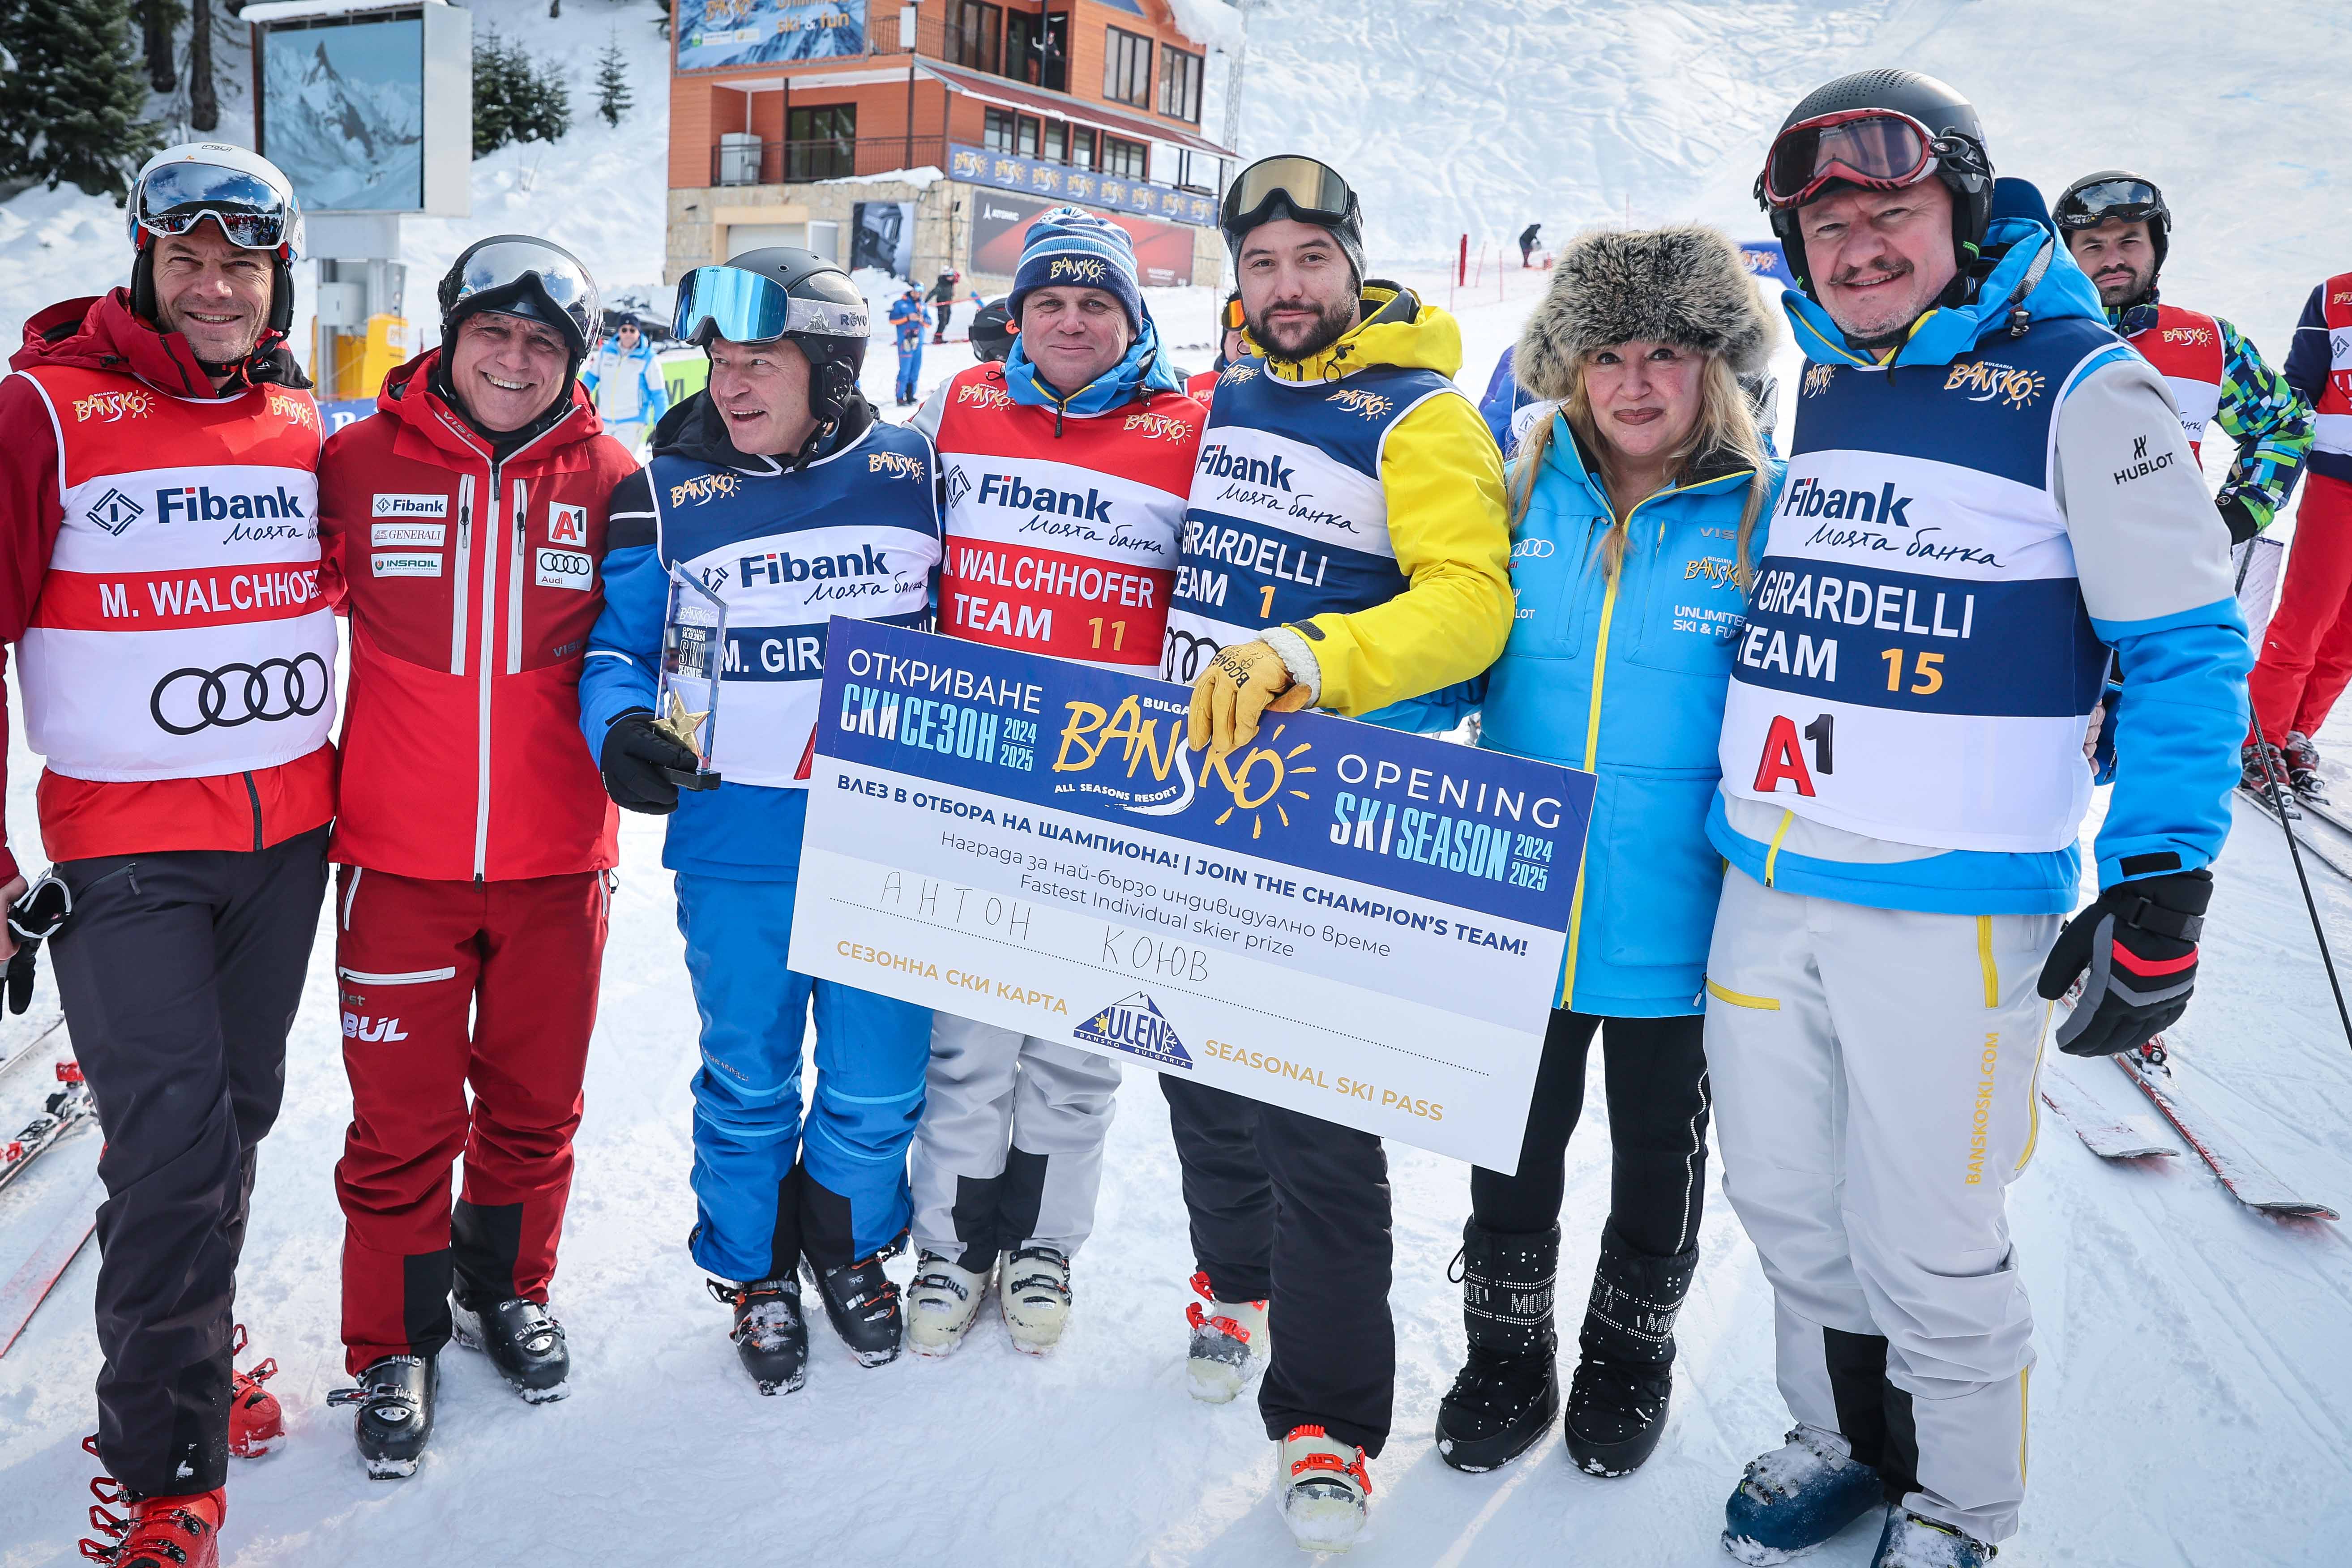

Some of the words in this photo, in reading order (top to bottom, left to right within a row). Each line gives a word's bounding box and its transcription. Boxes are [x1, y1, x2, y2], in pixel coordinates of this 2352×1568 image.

[778, 14, 801, 34] ski
[805, 20, 816, 30] &
[821, 11, 850, 29] fun
[1050, 256, 1101, 282] BANSKO
[2162, 328, 2209, 346] BANSKO
[1803, 363, 1833, 397] BANSKO
[1944, 360, 2033, 401] BANSKO
[1984, 360, 2013, 369] BULGARIA
[73, 391, 146, 423] BANSKO
[270, 394, 311, 425] BANSKO
[957, 383, 1011, 408] BANSKO
[1326, 389, 1385, 414] BANSKO
[1123, 413, 1186, 439] BANSKO
[690, 474, 711, 482] BULGARIA
[868, 452, 921, 479] BANSKO
[1196, 444, 1296, 492] Fibank
[2113, 452, 2174, 485] HUBLOT
[155, 486, 305, 524] Fibank
[393, 499, 444, 513] Fibank
[671, 474, 734, 507] BANSKO
[977, 473, 1114, 524] Fibank
[1783, 477, 1914, 528] Fibank
[1217, 482, 1285, 510] Моята
[1288, 494, 1360, 534] банка
[222, 522, 304, 545] Моята
[389, 529, 441, 540] GENERALI
[552, 509, 584, 541] A1
[1019, 514, 1105, 542] Моята
[1109, 524, 1166, 555] банка
[1182, 521, 1328, 587] GIRARDELLI
[1707, 556, 1732, 565] BULGARIA
[1805, 522, 1899, 550] Моята
[1906, 527, 2006, 568] банка
[386, 560, 437, 568] INSAOIL
[541, 576, 564, 585] Audi
[740, 544, 890, 588] Fibank
[959, 547, 1154, 609] WALCHHOFER
[99, 583, 139, 617] M.
[804, 582, 888, 605] Моята
[1258, 585, 1276, 619] 1
[1758, 569, 1975, 639] GIRARDELLI
[680, 606, 710, 625] BANSKO
[954, 594, 1053, 642] TEAM
[1088, 617, 1126, 651] 11
[1515, 608, 1536, 620] LOT
[1673, 619, 1697, 633] SKI
[1700, 623, 1711, 635] &
[682, 631, 706, 642] 14.12.2024
[683, 627, 706, 636] OPENING
[679, 639, 706, 668] SKI
[720, 639, 749, 672] M.
[1737, 622, 1838, 682] TEAM
[1881, 648, 1945, 695] 15
[678, 665, 696, 679] SEASON
[847, 648, 1043, 714] ОТКРИВАНЕ
[1212, 654, 1250, 689] BOGNE
[1143, 696, 1189, 715] BULGA
[840, 683, 900, 741] СКИ
[900, 695, 998, 764] СЕЗОН
[1002, 717, 1037, 744] 2024
[999, 743, 1034, 772] 2025
[1052, 694, 1285, 816] BANSKO
[1753, 713, 1834, 798] A1
[1054, 783, 1076, 794] ALL
[1080, 783, 1130, 801] SEASONS
[1134, 785, 1177, 803] RESORT
[1337, 754, 1562, 829] OPENING
[1330, 791, 1396, 855] SKI
[1396, 807, 1511, 882] SEASON
[1514, 833, 1553, 863] 2024
[837, 773, 889, 799] ВЛЕЗ
[894, 788, 907, 804] В
[913, 792, 996, 826] ОТБОРА
[1002, 812, 1032, 834] НА
[1038, 820, 1180, 869] ШАМПИОНА!
[1195, 859, 1248, 886] JOIN
[1253, 873, 1296, 898] THE
[1455, 923, 1529, 957] TEAM!
[1509, 861, 1548, 892] 2025
[941, 830, 1023, 865] Награда
[1026, 854, 1048, 872] за
[1054, 860, 1157, 898] най-бързо
[1163, 888, 1316, 939] индивидуално
[1322, 925, 1391, 959] време
[881, 871, 1031, 940] АНТОН
[1103, 925, 1209, 982] КОЮВ
[1021, 873, 1087, 904] Fastest
[1092, 893, 1187, 930] Individual
[1193, 919, 1241, 944] skier
[1246, 932, 1295, 957] prize
[837, 940, 939, 981] СЕЗОННА
[945, 969, 991, 994] СКИ
[996, 984, 1069, 1016] КАРТА
[343, 1011, 409, 1042] BUL
[1106, 1005, 1167, 1054] ULEN
[1079, 1032, 1120, 1048] BANSKO
[1134, 1047, 1187, 1068] BULGARIA
[1204, 1039, 1330, 1089] SEASONAL
[1336, 1077, 1375, 1101] SKI
[1381, 1089, 1444, 1121] PASS
[1965, 1032, 1999, 1185] BANSKOSKI.COM
